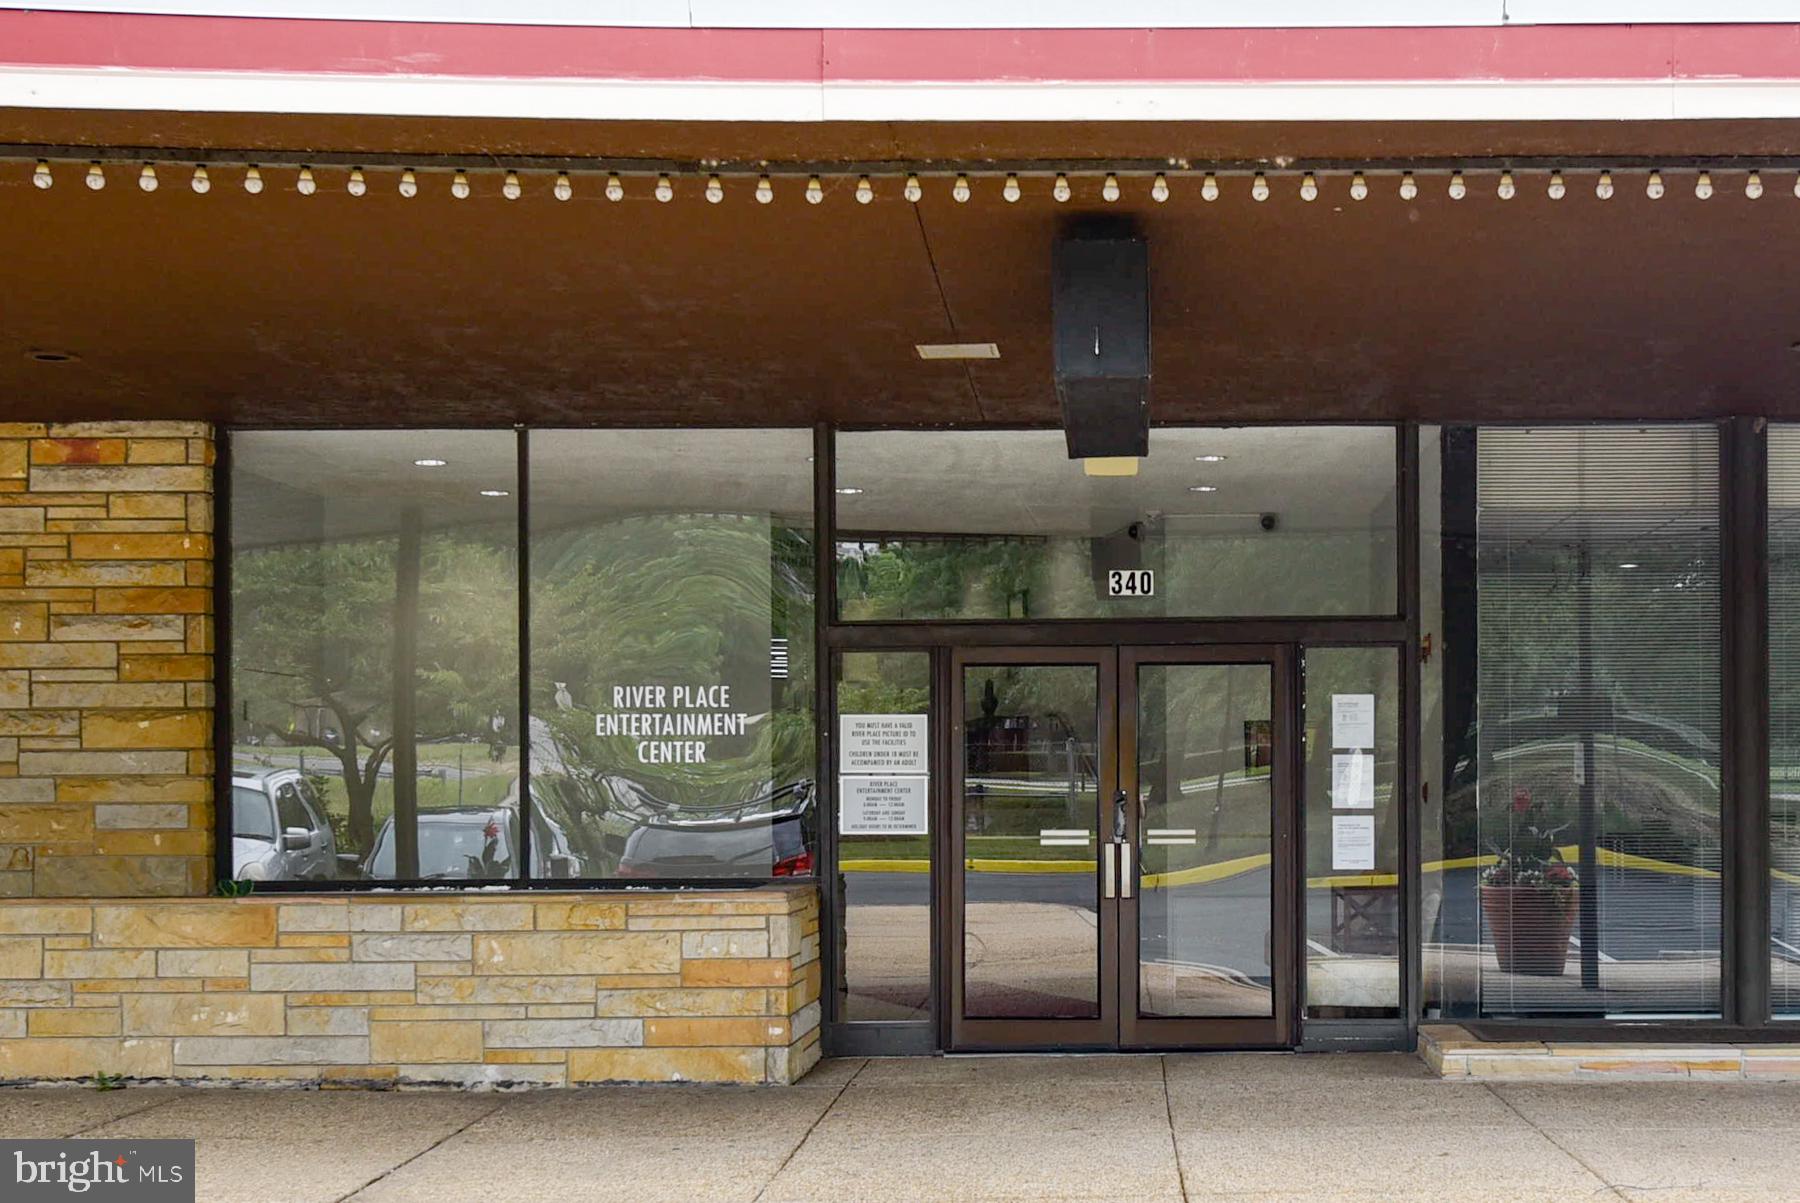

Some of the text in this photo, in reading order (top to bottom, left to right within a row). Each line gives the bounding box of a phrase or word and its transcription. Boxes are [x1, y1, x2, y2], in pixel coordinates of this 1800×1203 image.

[1112, 572, 1152, 594] 340
[613, 686, 730, 708] RIVER PLACE
[596, 714, 748, 736] ENTERTAINMENT
[638, 741, 706, 764] CENTER
